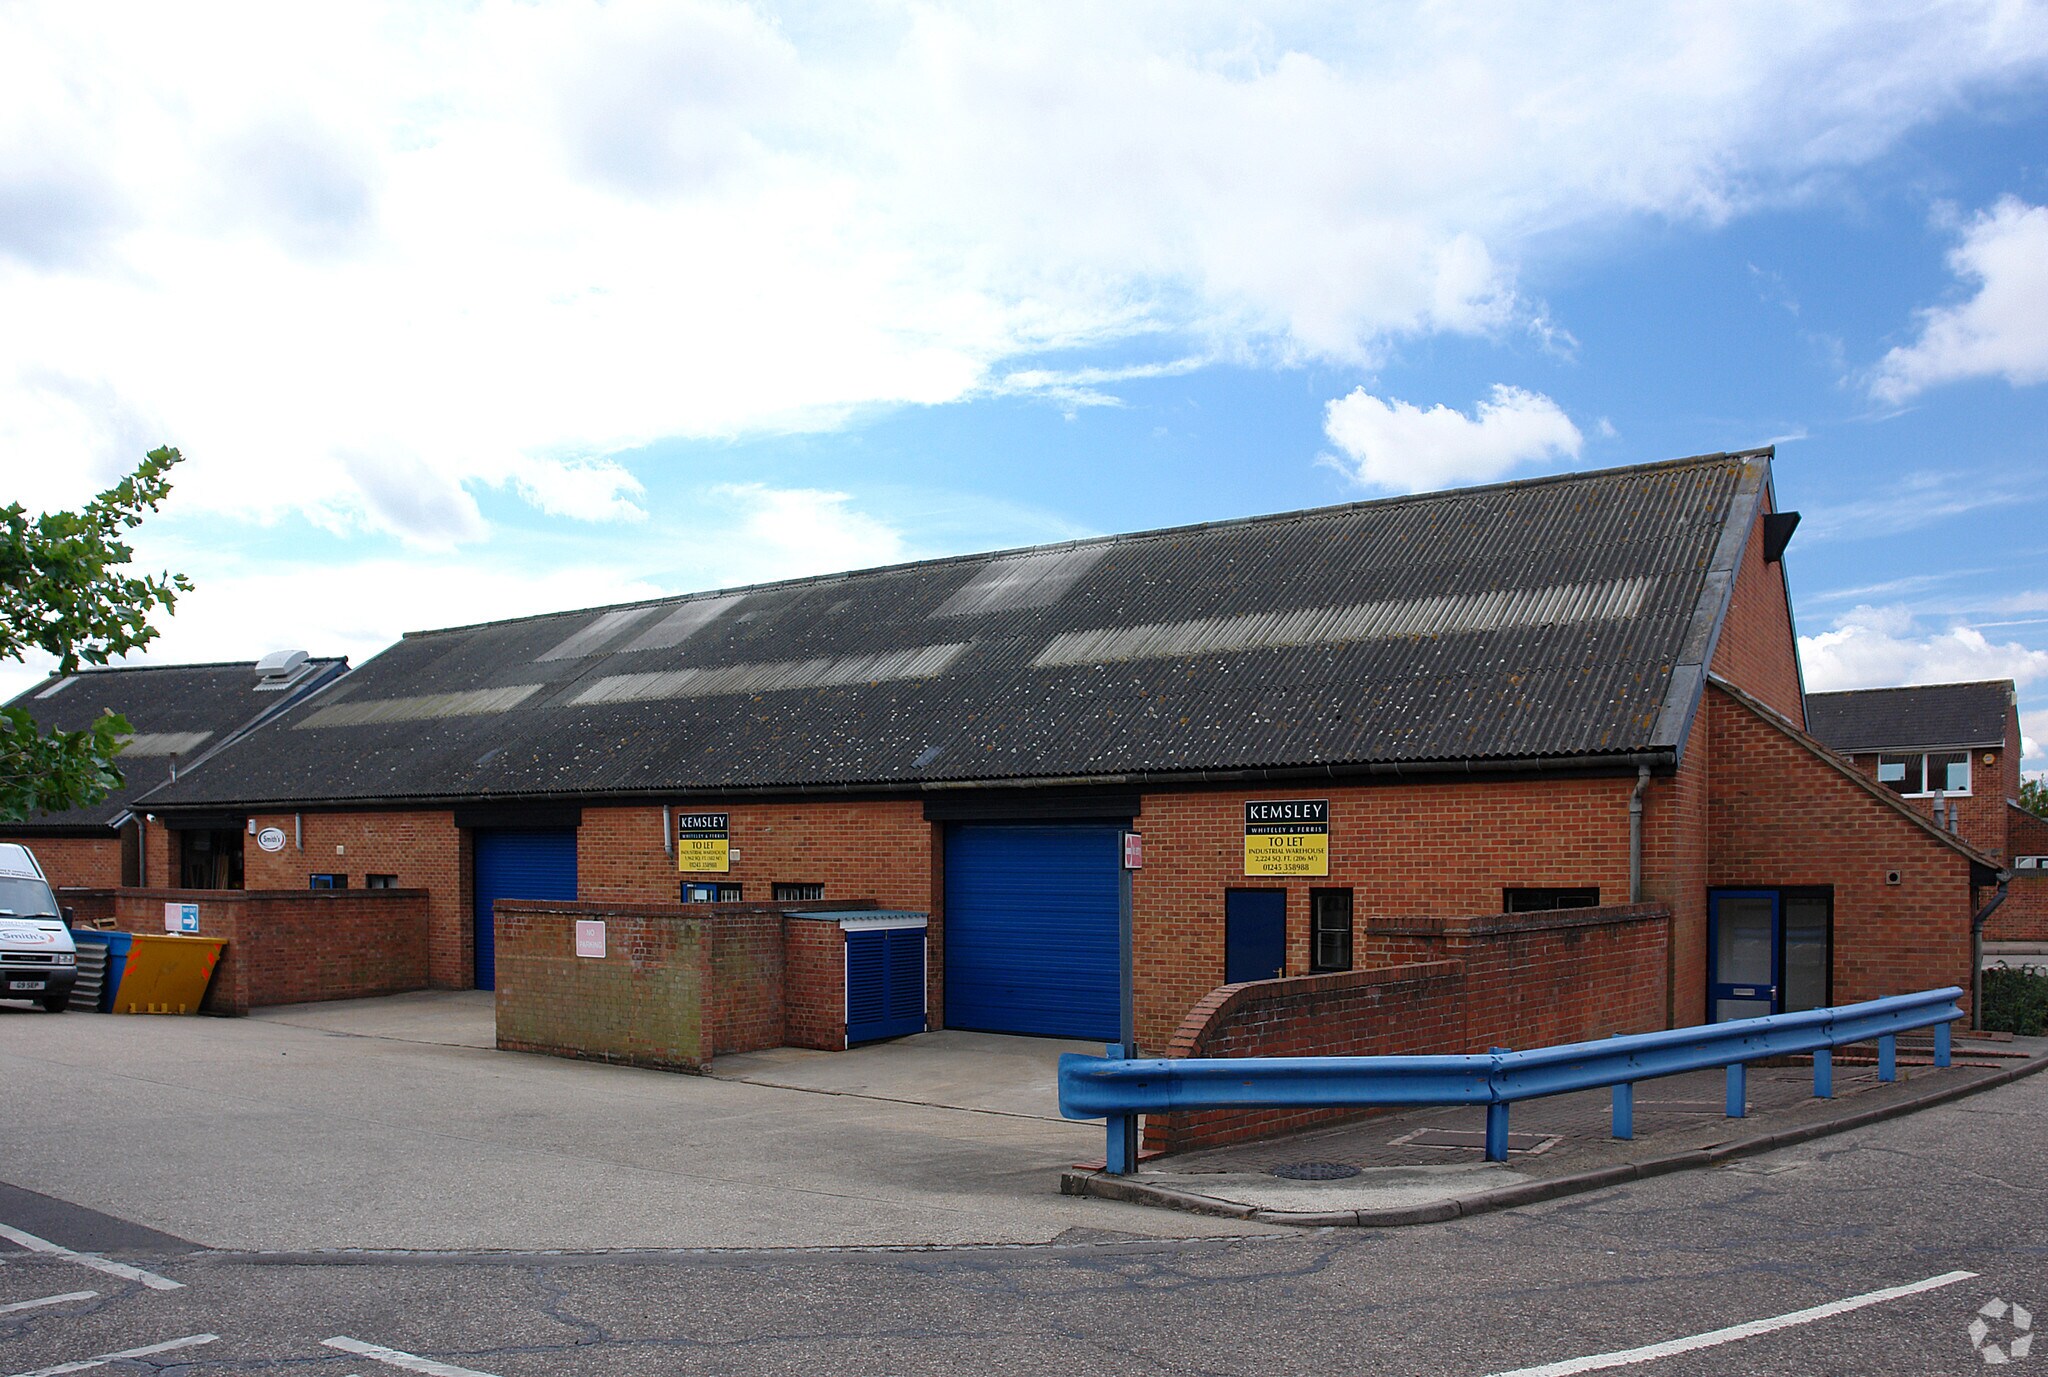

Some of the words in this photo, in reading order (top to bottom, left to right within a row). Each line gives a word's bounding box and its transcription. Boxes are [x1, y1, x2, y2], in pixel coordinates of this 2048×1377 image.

[1250, 804, 1322, 819] KEMSLEY
[681, 816, 725, 828] KEMSLEY
[263, 835, 280, 843] Smith's
[1268, 837, 1283, 847] TO
[1287, 836, 1304, 847] LET
[692, 841, 702, 849] TO
[703, 841, 714, 849] LET
[1284, 863, 1310, 871] 358988
[3, 932, 45, 940] Smith's
[579, 940, 602, 949] PARKING
